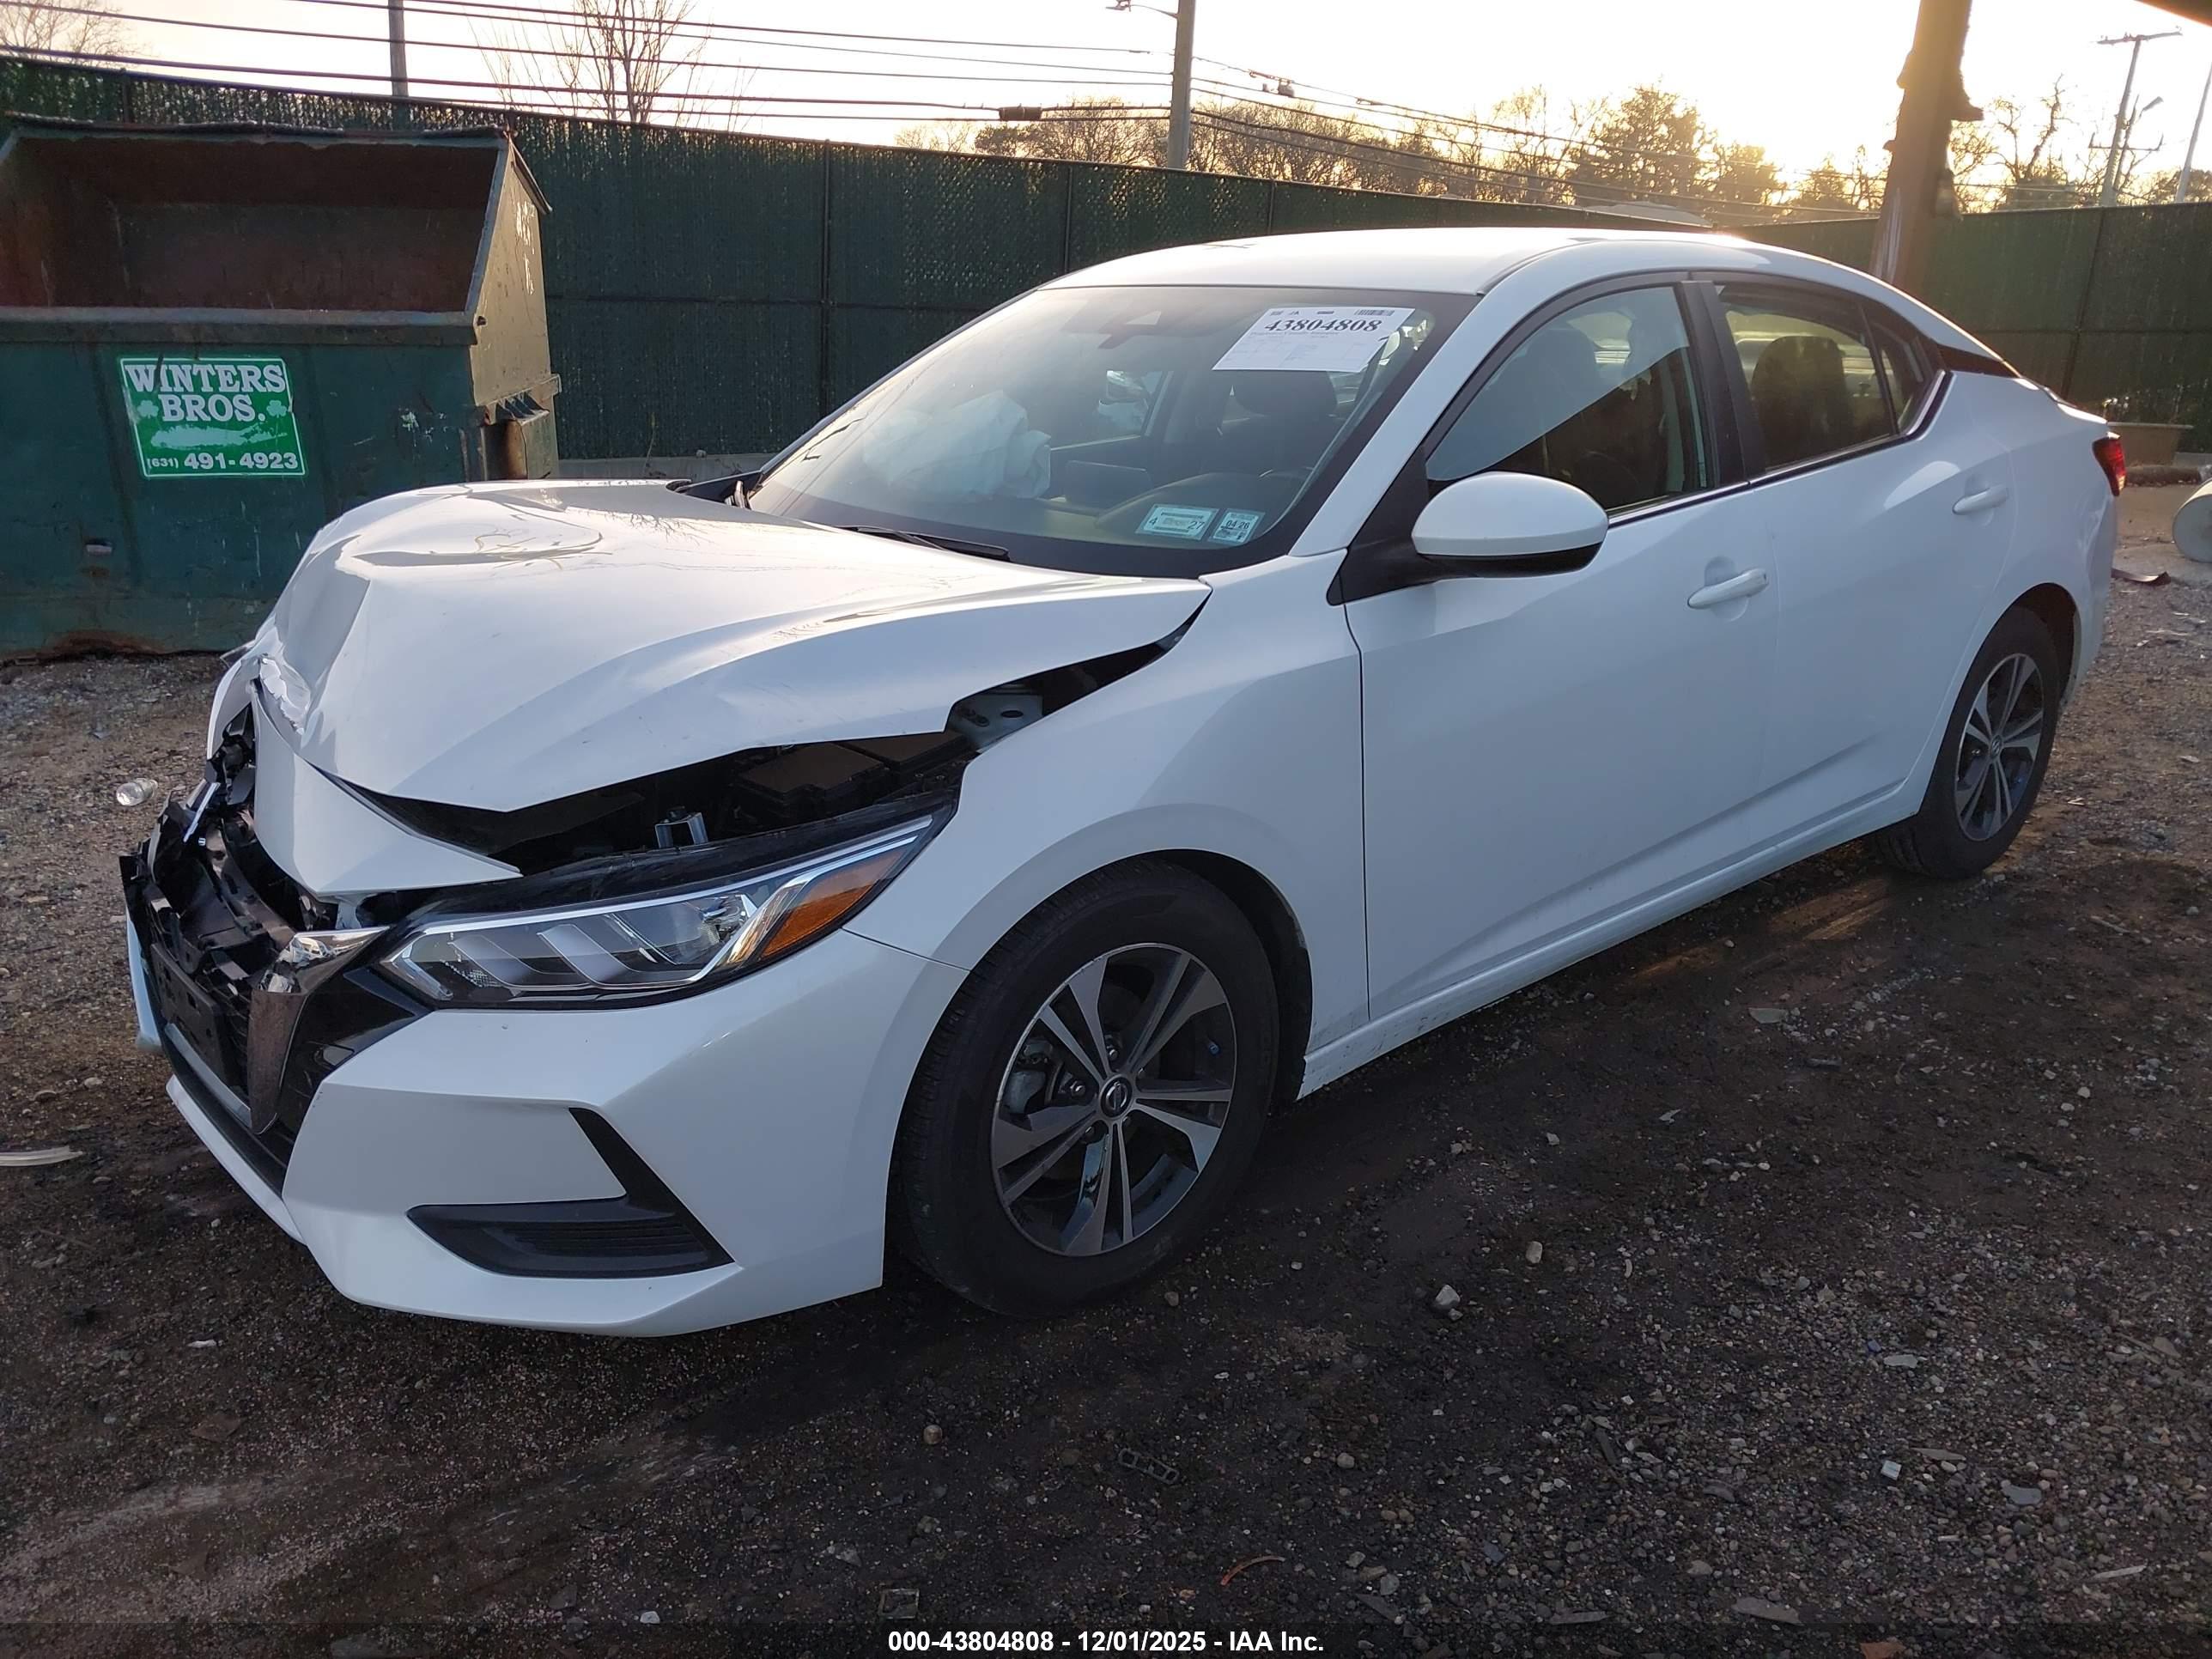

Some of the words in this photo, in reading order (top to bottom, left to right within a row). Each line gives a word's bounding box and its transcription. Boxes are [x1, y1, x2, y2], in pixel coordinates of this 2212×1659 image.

[1264, 319, 1382, 331] 43804808
[125, 364, 286, 392] WINTERS
[158, 394, 266, 422] BROS.
[147, 458, 179, 469] (631)
[184, 453, 299, 469] 491-4923
